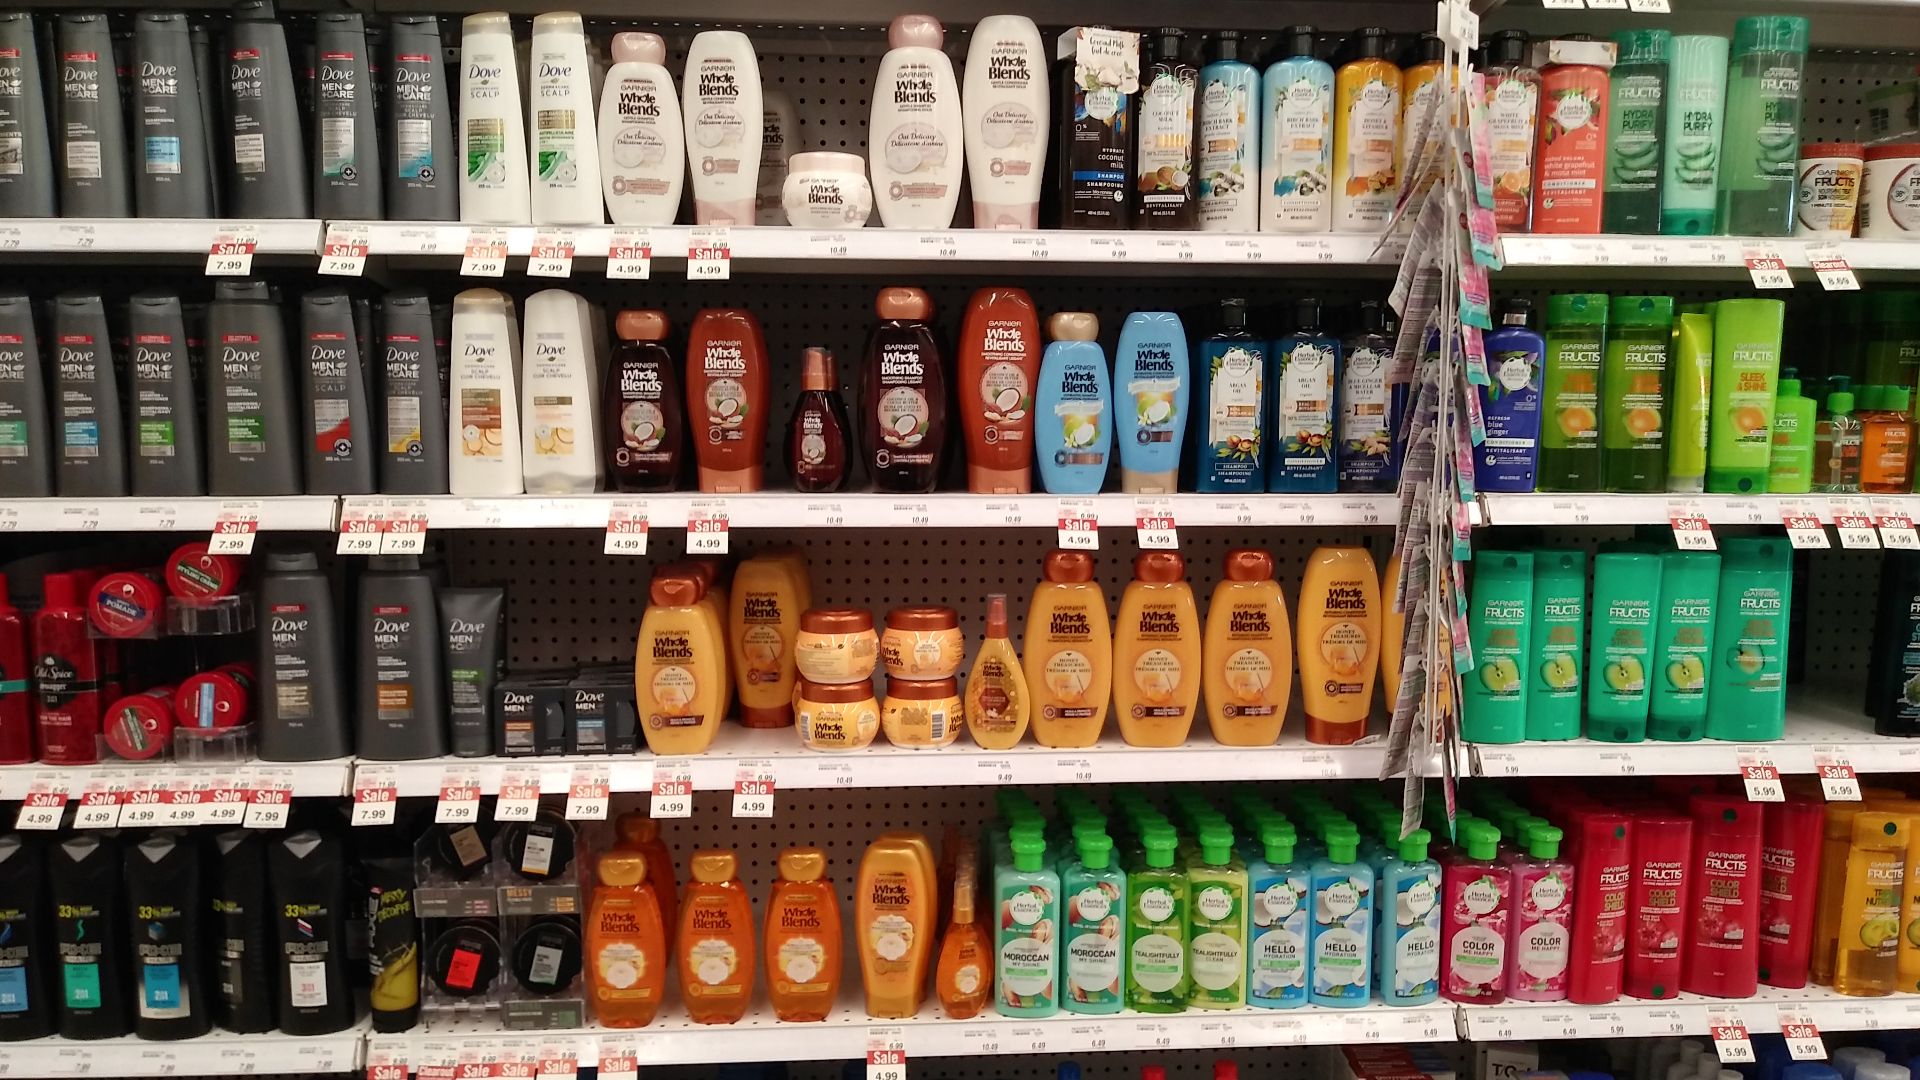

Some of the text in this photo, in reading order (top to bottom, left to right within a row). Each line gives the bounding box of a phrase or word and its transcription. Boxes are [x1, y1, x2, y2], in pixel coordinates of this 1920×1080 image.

[991, 57, 1026, 68] Whole
[142, 62, 177, 78] Dove
[321, 66, 354, 81] Dove
[469, 64, 500, 78] Dove
[539, 63, 571, 77] Dove
[989, 66, 1030, 80] Blends
[700, 74, 734, 84] Whole
[322, 83, 342, 91] MEN
[699, 83, 739, 96] Blends
[541, 89, 569, 97] SCALP
[1619, 87, 1660, 98] FRUCTIS
[621, 93, 655, 103] Whole
[618, 102, 660, 117] Blends
[1623, 110, 1653, 119] HYDRA
[1684, 112, 1712, 121] HYDRA
[1623, 120, 1653, 129] PURIFY
[1684, 121, 1712, 132] PURIFY
[1815, 177, 1855, 187] FRUCTIS
[218, 244, 246, 255] Sale
[331, 245, 359, 256] Sale
[472, 247, 500, 258] Sale
[538, 246, 567, 257] Sale
[615, 247, 643, 258] Sale
[695, 248, 723, 259] Sale
[216, 261, 242, 269] 7.99
[330, 262, 355, 270] 7.99
[472, 263, 496, 271] 7.99
[616, 265, 641, 273] 4.99
[697, 266, 721, 274] 4.99
[1753, 260, 1778, 271] Sale
[1761, 276, 1783, 284] 5.99
[987, 328, 1021, 340] Whole
[984, 338, 1025, 351] Blends
[60, 348, 94, 363] Dove
[137, 347, 171, 362] Dove
[312, 345, 345, 360] Dove
[465, 344, 494, 358] Dove
[1137, 350, 1170, 361] Whole
[883, 352, 918, 364] Whole
[1559, 351, 1600, 362] FRUCTIS
[1733, 352, 1772, 362] FRUCTIS
[61, 364, 81, 372] MEN
[881, 361, 924, 374] Blends
[1135, 358, 1173, 371] Blends
[623, 370, 657, 381] Whole
[1064, 372, 1095, 383] Whole
[1740, 373, 1764, 382] SLEEK
[621, 379, 662, 392] Blends
[1062, 380, 1097, 393] Blends
[1744, 382, 1767, 391] SHINE
[221, 522, 249, 533] Sale
[348, 522, 376, 532] Sale
[391, 522, 419, 533] Sale
[615, 521, 640, 533] Sale
[695, 520, 721, 532] Sale
[1065, 519, 1090, 531] Sale
[1143, 519, 1168, 529] Sale
[1679, 519, 1702, 529] Sale
[1791, 518, 1814, 528] Sale
[1841, 517, 1865, 528] Sale
[347, 540, 372, 548] 7.99
[391, 539, 415, 548] 7.99
[614, 539, 638, 549] 4.99
[696, 539, 720, 548] 4.99
[1068, 536, 1090, 545] 4.99
[1147, 535, 1169, 544] 4.99
[1685, 536, 1707, 544] 5.99
[1798, 535, 1820, 543] 5.99
[1849, 535, 1869, 543] 5.99
[219, 540, 244, 549] 7.99
[1328, 588, 1362, 598] Whole
[106, 600, 136, 615] POMADE
[1326, 597, 1365, 608] Blends
[1741, 598, 1780, 608] FRUCTIS
[1485, 608, 1524, 618] FRUCTIS
[1545, 605, 1580, 615] FRUCTIS
[1610, 607, 1649, 618] FRUCTIS
[1052, 614, 1086, 624] Whole
[272, 618, 307, 633] Dove
[450, 619, 484, 633] Dove
[1050, 622, 1090, 633] Blends
[655, 638, 688, 648] Whole
[653, 647, 693, 658] Blends
[504, 692, 533, 704] Dove
[815, 724, 843, 733] Whole
[815, 731, 845, 740] Blends
[1747, 768, 1772, 779] Sale
[1824, 767, 1848, 778] Sale
[577, 786, 604, 797] Sale
[659, 783, 684, 795] Sale
[741, 782, 766, 794] Sale
[1754, 787, 1775, 796] 5.99
[1831, 786, 1852, 795] 5.99
[88, 793, 115, 804] Sale
[132, 791, 159, 802] Sale
[256, 792, 284, 802] Sale
[362, 791, 389, 802] Sale
[446, 788, 472, 800] Sale
[32, 794, 59, 806] Sale
[445, 807, 469, 816] 7.99
[575, 805, 600, 814] 7.99
[660, 803, 684, 812] 4.99
[741, 802, 764, 811] 4.99
[28, 814, 52, 823] 4.99
[85, 813, 109, 821] 4.99
[129, 811, 153, 820] 4.99
[255, 812, 278, 821] 7.99
[361, 810, 385, 819] 7.99
[1708, 852, 1745, 860] GARNIER
[1705, 860, 1746, 870] FRUCTIS
[1711, 880, 1739, 888] COLOR
[874, 885, 905, 895] Whole
[1649, 890, 1676, 899] COLOR
[1710, 889, 1738, 898] SHIELD
[873, 894, 910, 905] Blends
[1649, 898, 1676, 907] SHIELD
[695, 910, 727, 920] Whole
[693, 918, 731, 929] Blends
[1463, 941, 1494, 950] COLOR
[1531, 938, 1561, 946] COLOR
[1265, 945, 1295, 953] HELLO
[1004, 952, 1049, 961] MOROCCAN
[1718, 1028, 1741, 1039] Sale
[1789, 1026, 1812, 1038] Sale
[1726, 1049, 1746, 1057] 5.99
[1797, 1046, 1817, 1054] 5.99
[873, 1052, 898, 1064] Sale
[604, 1059, 629, 1071] Sale
[465, 1066, 489, 1078] Sale
[875, 1072, 897, 1080] 4.99
